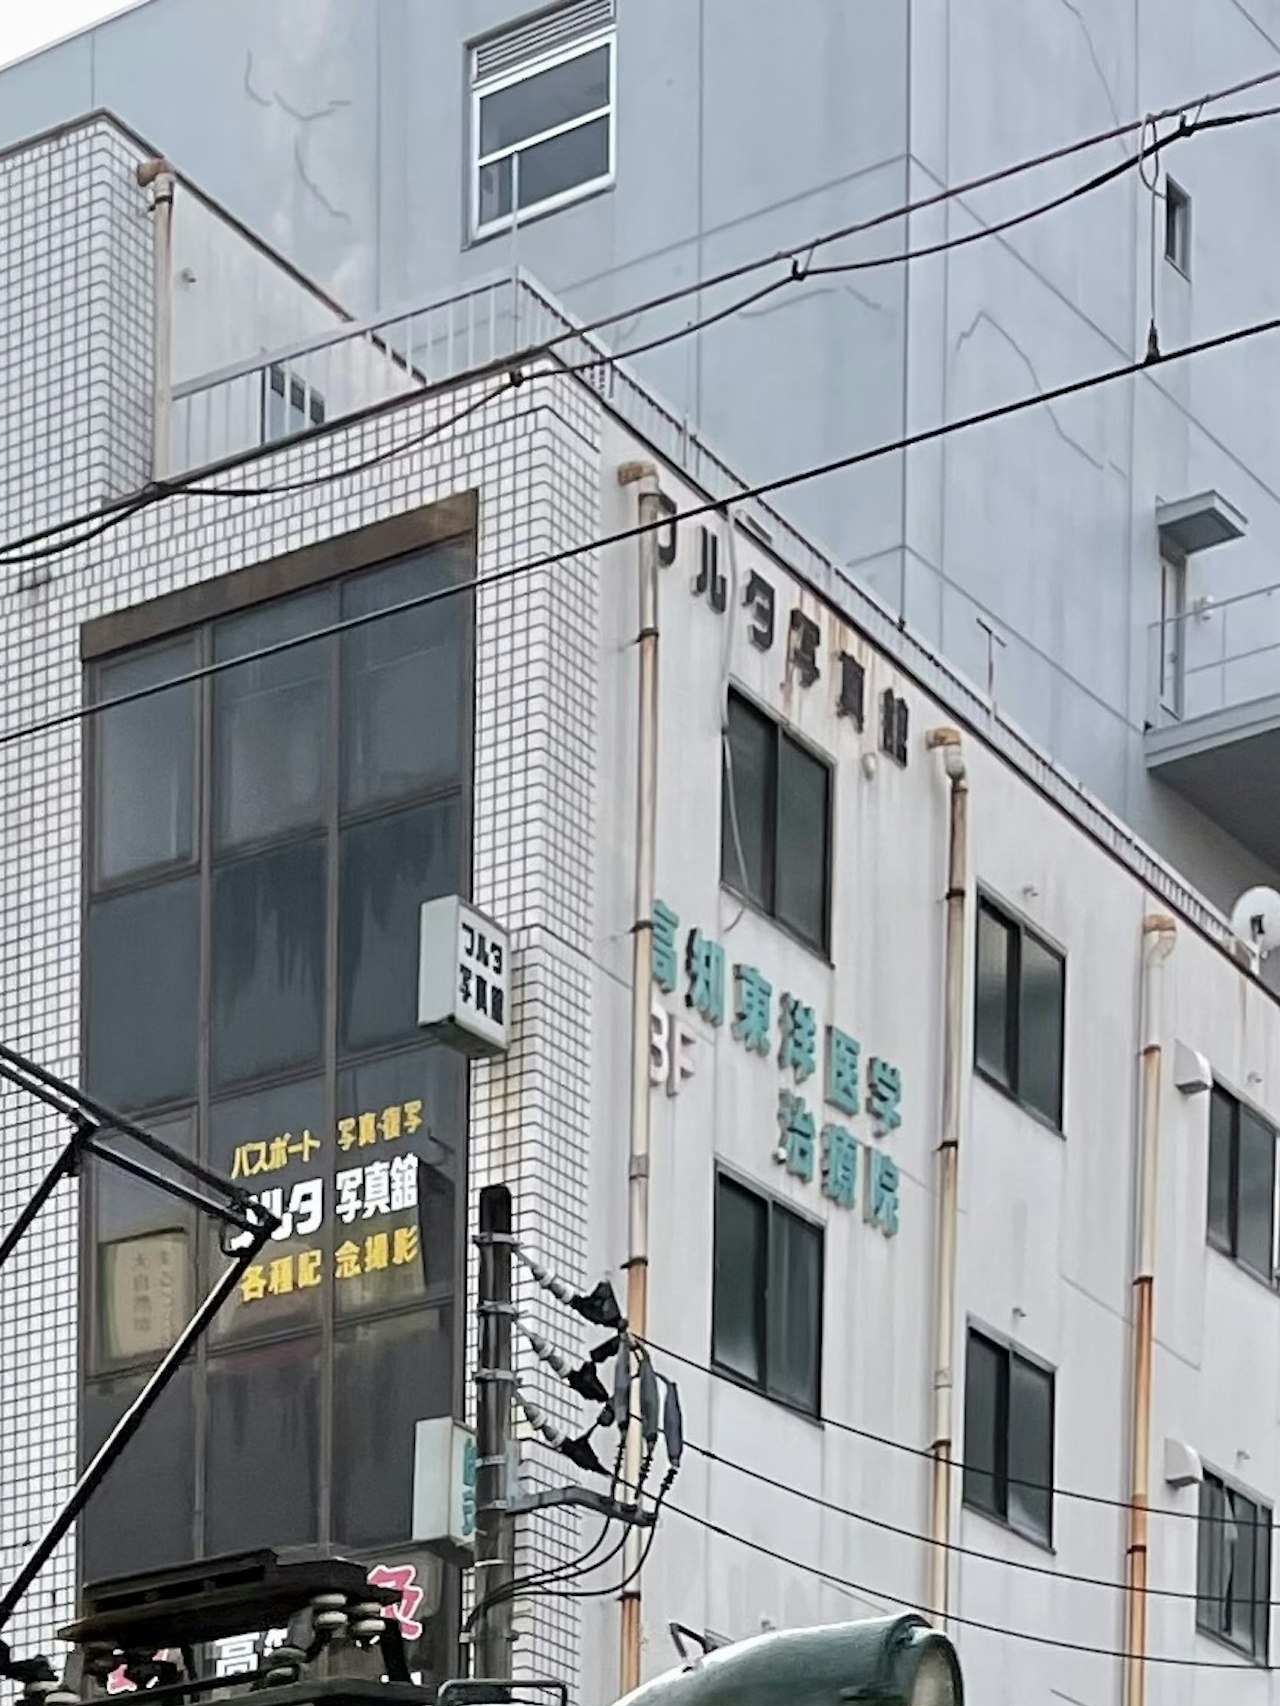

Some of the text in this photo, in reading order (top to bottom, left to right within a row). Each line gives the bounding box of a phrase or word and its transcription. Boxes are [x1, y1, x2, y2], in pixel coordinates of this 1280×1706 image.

[461, 921, 503, 975] フルタ
[651, 899, 901, 1138] 高知東洋医学
[776, 1087, 900, 1238] 治療院
